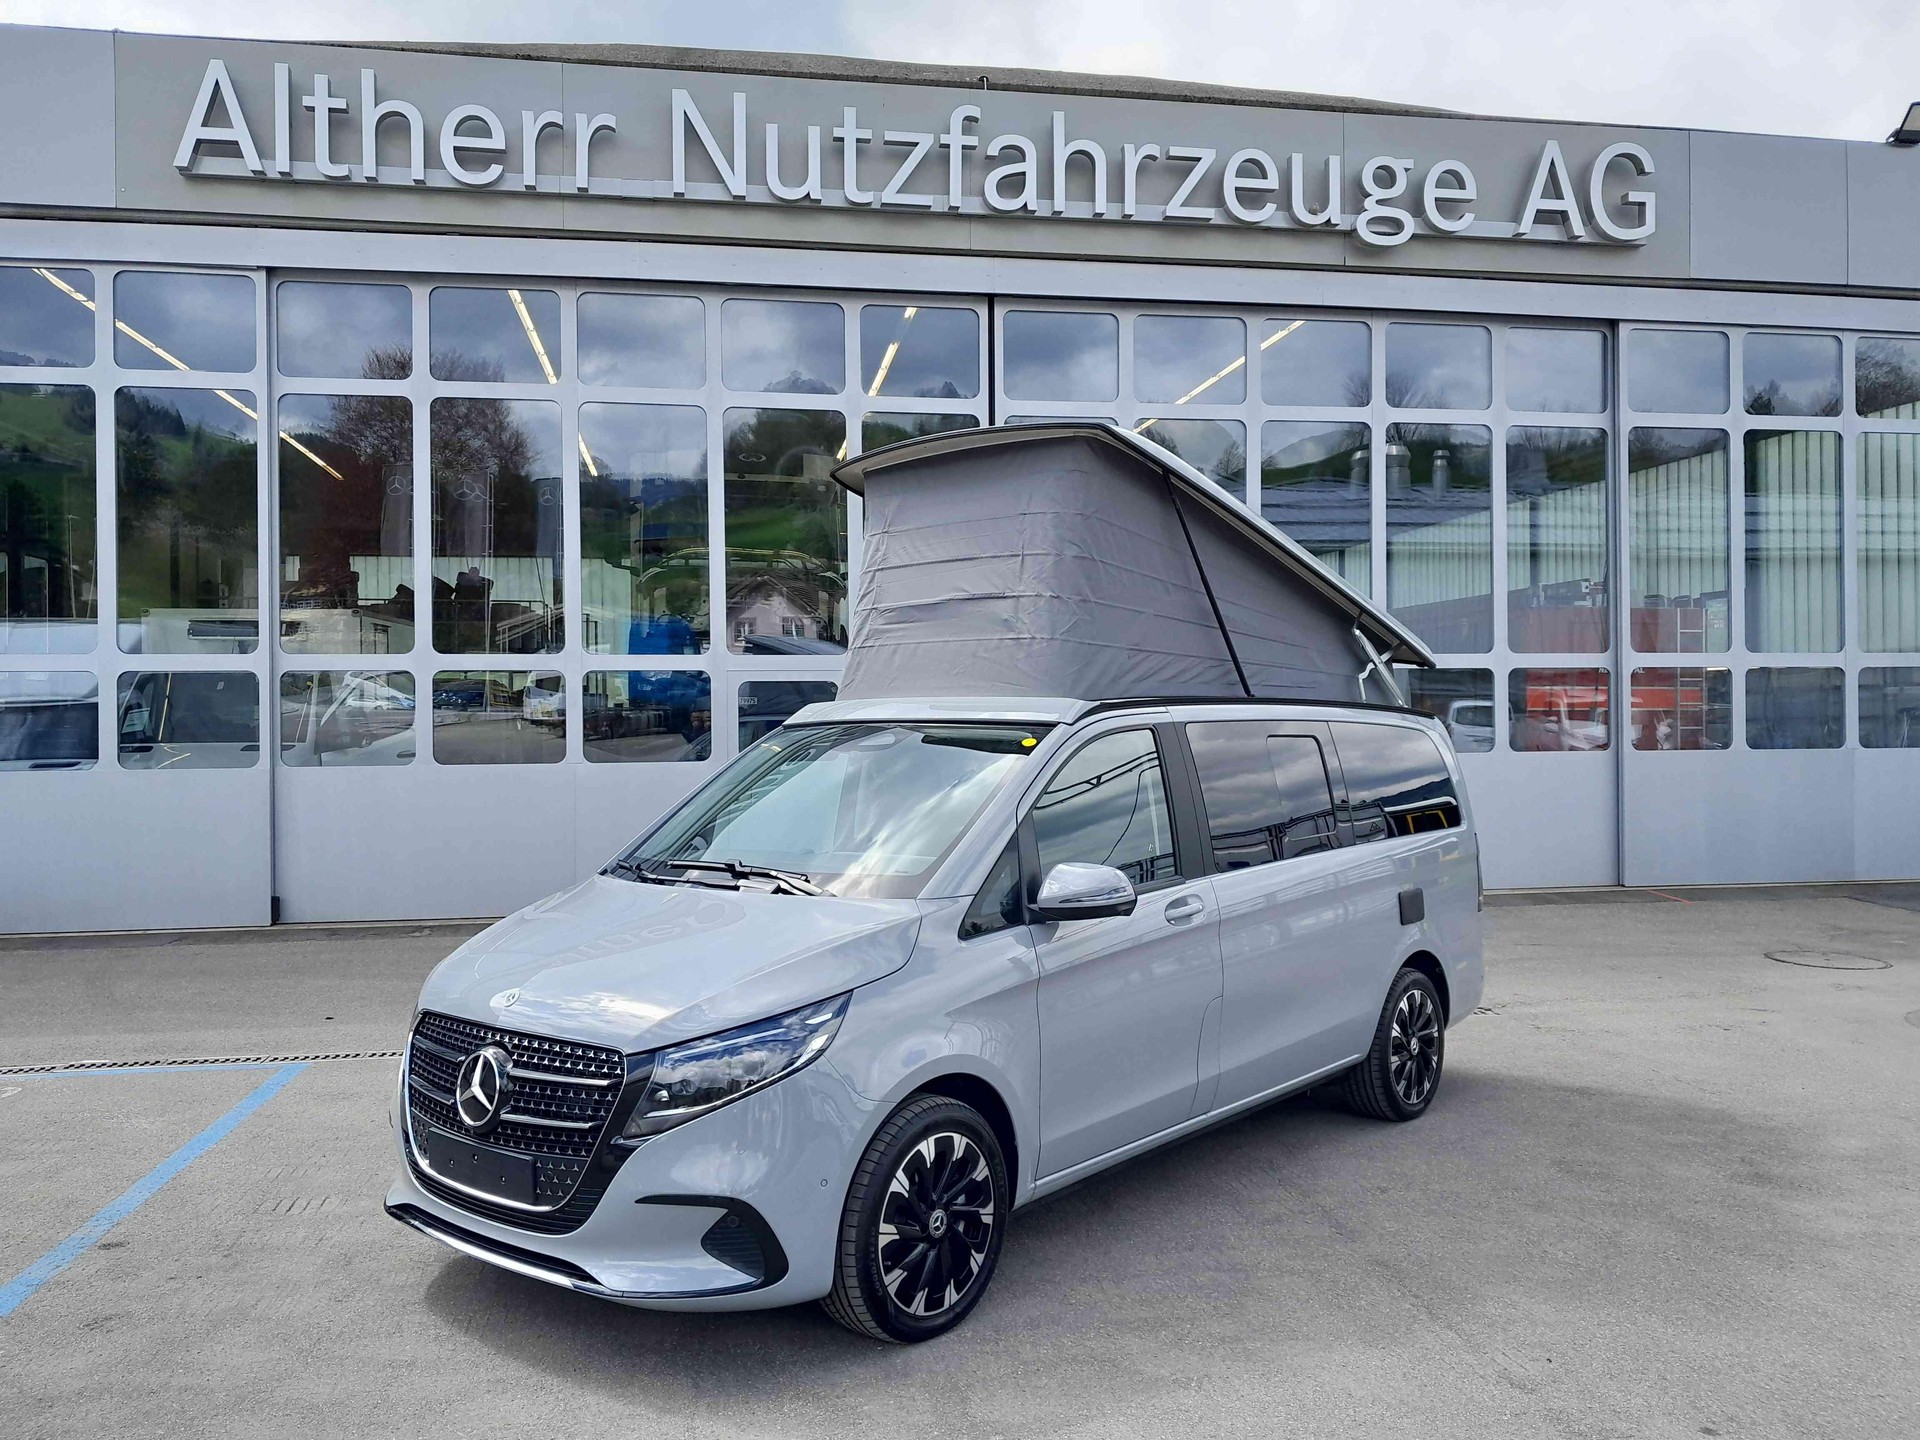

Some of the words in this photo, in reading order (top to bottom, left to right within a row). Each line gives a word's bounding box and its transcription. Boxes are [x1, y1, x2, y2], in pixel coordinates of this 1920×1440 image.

[173, 58, 617, 192] Altherr
[671, 88, 1478, 247] Nutzfahrzeuge
[1513, 139, 1656, 241] AG
